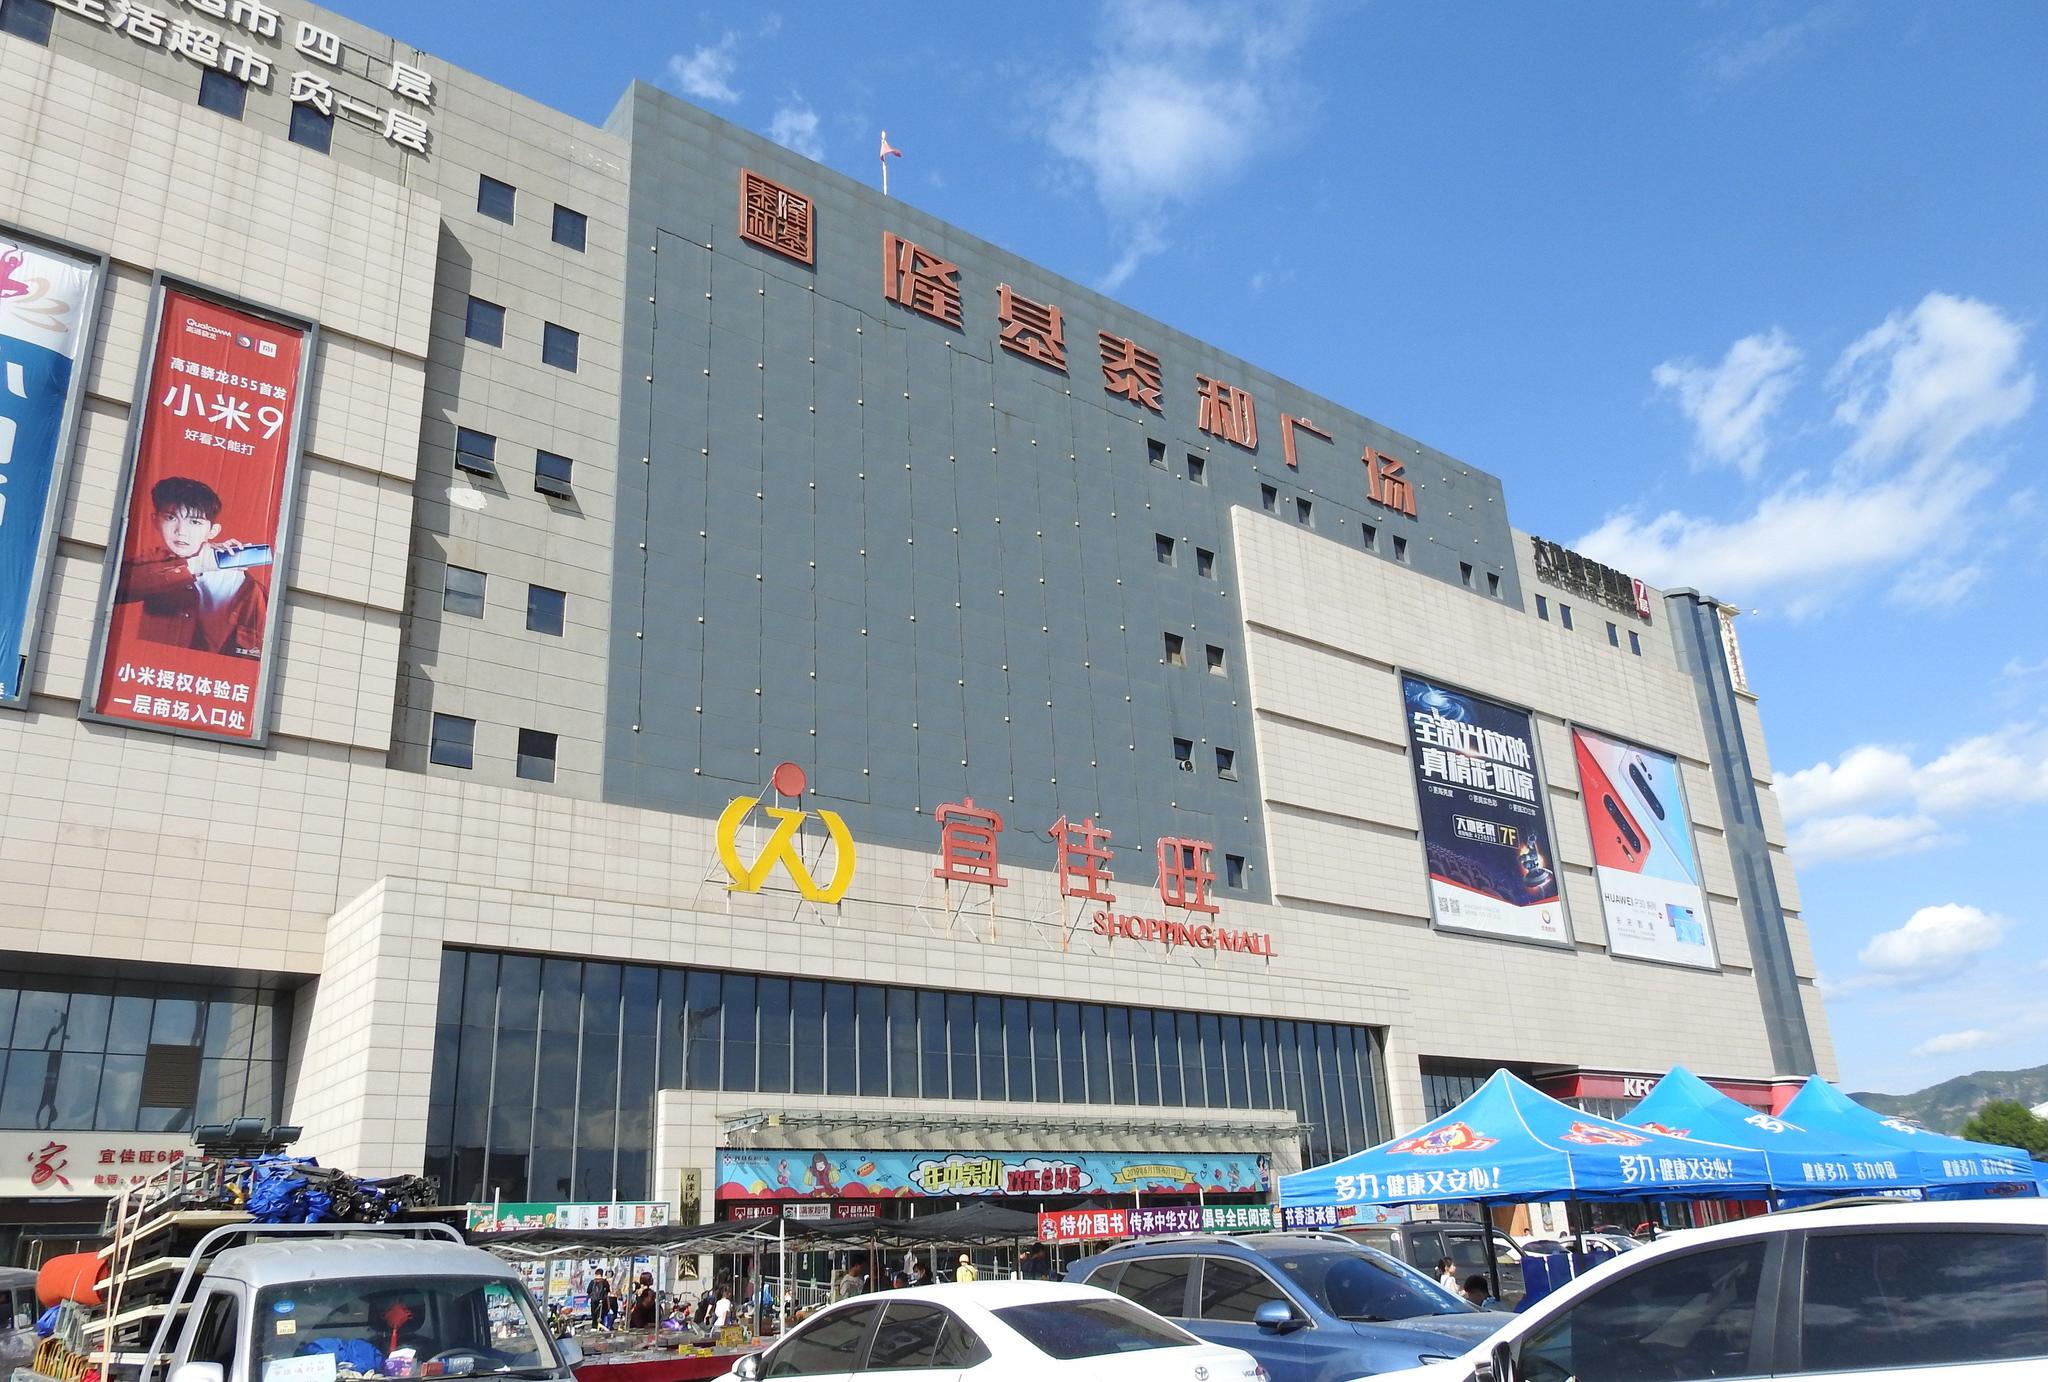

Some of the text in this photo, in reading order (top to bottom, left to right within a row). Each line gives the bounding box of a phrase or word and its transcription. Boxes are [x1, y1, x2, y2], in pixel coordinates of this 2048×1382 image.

[290, 71, 428, 153] 负一层
[170, 357, 287, 400] 高通骁龙855首发
[163, 384, 284, 439] 小米9
[184, 428, 255, 456] 好看又能打
[118, 663, 250, 703] 小米授权体验店
[113, 694, 245, 730] 一层商场入口处
[1500, 827, 1516, 845] 7F
[934, 797, 1220, 914] 宜佳旺
[1604, 893, 1634, 906] HUAWEI
[1092, 911, 1279, 957] SHOPPING MALL
[1624, 1078, 1656, 1097] KFC
[1007, 1167, 1082, 1192] 欢乐总动员
[1060, 1213, 1124, 1236] 特价图书
[1130, 1211, 1199, 1232] 传承中华文化
[1202, 1208, 1272, 1228] 倡导全民阅读
[1285, 1206, 1337, 1228] 书香溢承德
